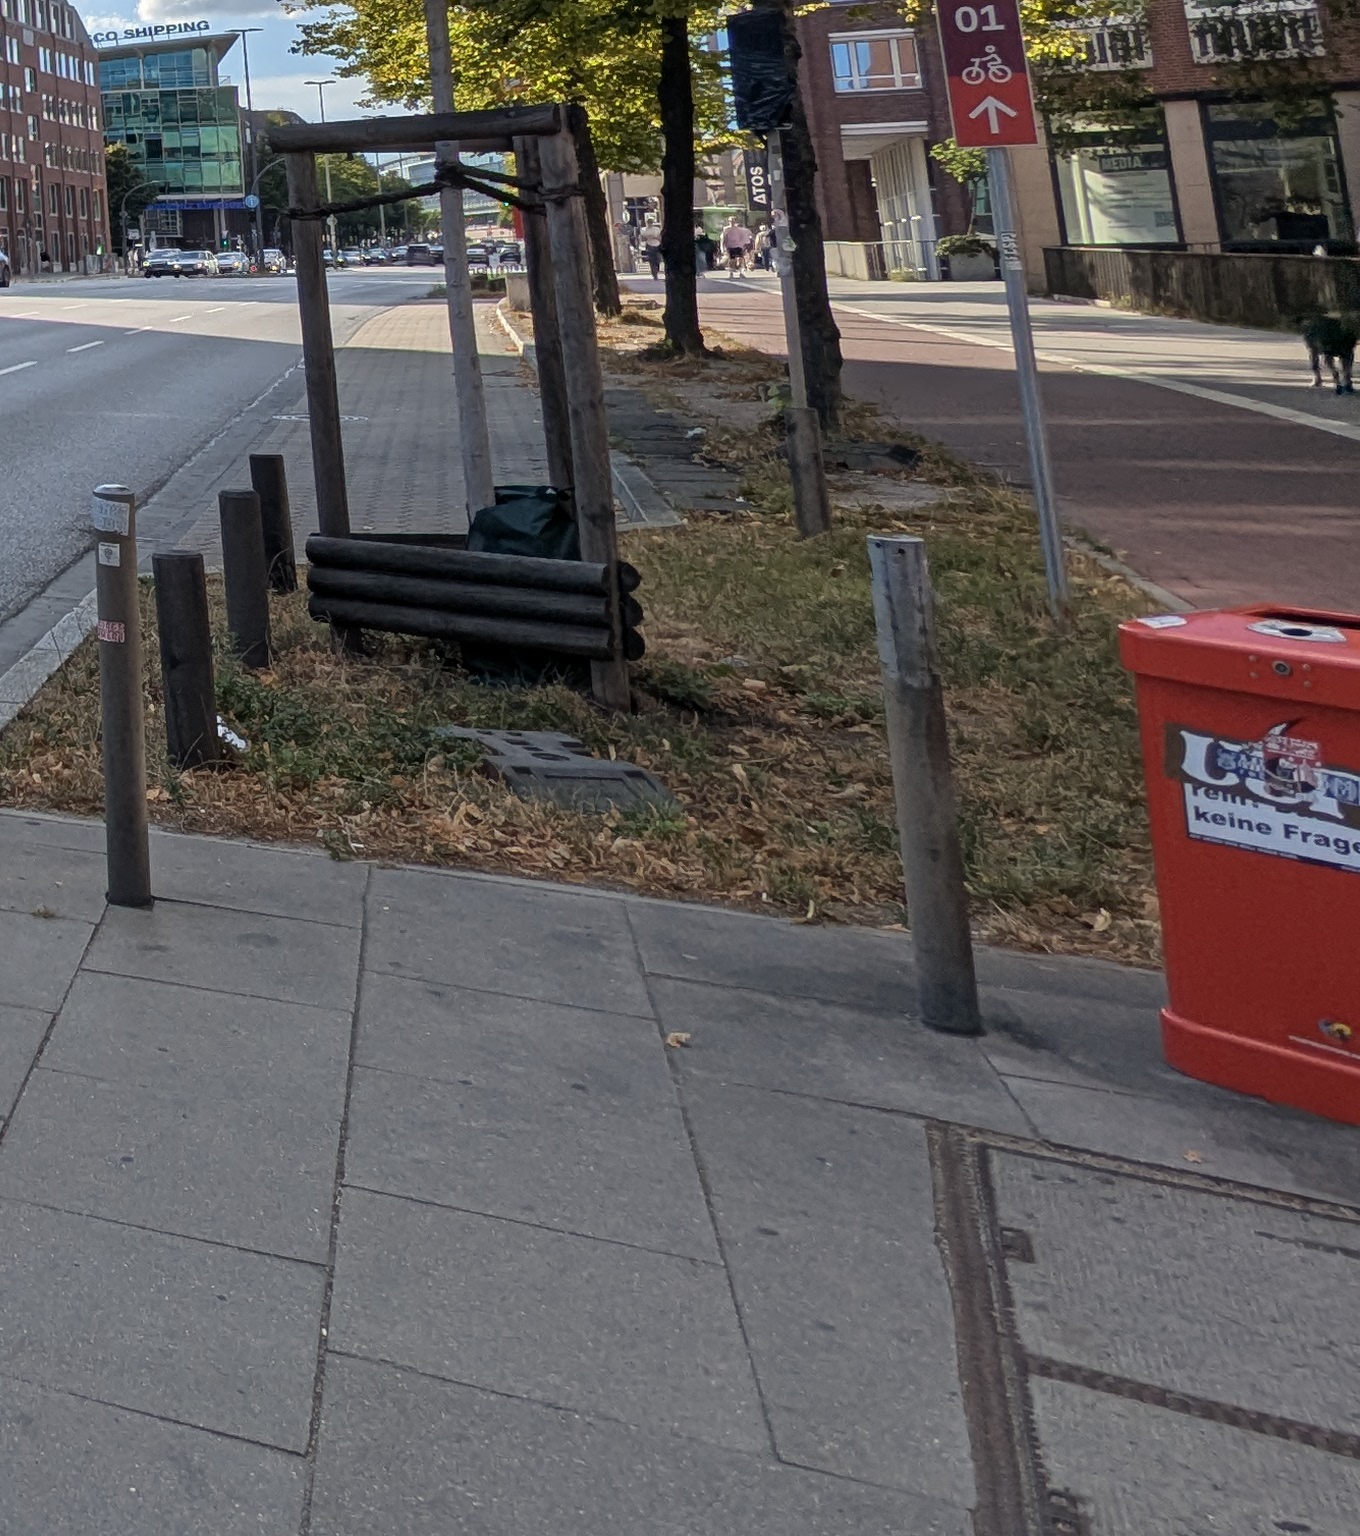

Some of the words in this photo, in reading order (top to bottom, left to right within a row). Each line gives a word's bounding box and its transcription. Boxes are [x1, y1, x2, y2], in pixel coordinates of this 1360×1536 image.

[123, 20, 210, 40] SHIPPING
[955, 4, 1005, 33] 01
[1193, 805, 1272, 836] keine
